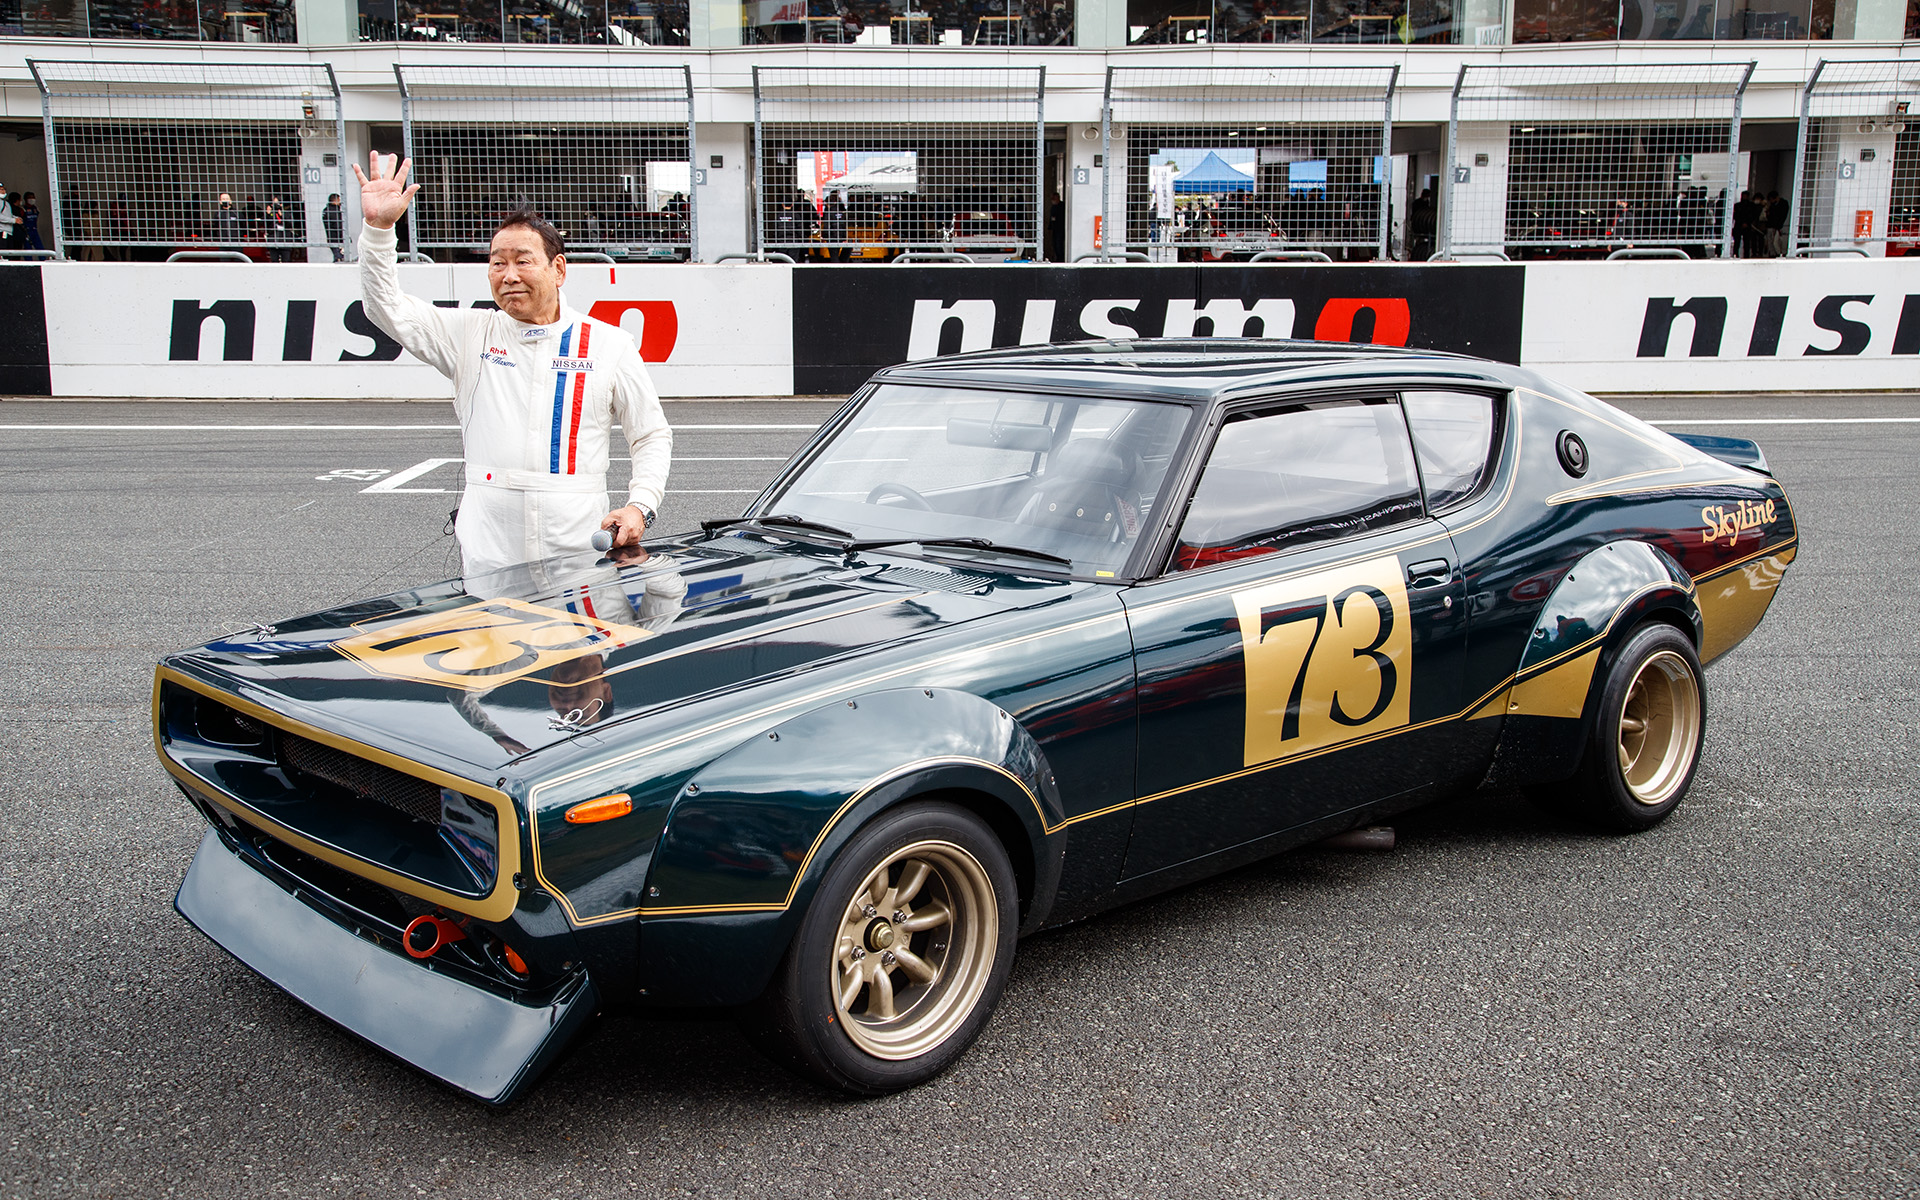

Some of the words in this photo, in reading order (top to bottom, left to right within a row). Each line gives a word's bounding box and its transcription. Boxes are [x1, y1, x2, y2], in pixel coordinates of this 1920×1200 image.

[305, 169, 320, 182] 10
[695, 170, 703, 183] 9
[1077, 170, 1086, 183] 8
[1458, 169, 1467, 181] 7
[1842, 165, 1851, 177] 6
[169, 299, 678, 362] niso
[1636, 294, 1920, 357] nis
[552, 360, 593, 369] NISSAN
[1701, 498, 1778, 547] Skyline
[369, 603, 611, 676] 73
[1259, 584, 1397, 742] 73
